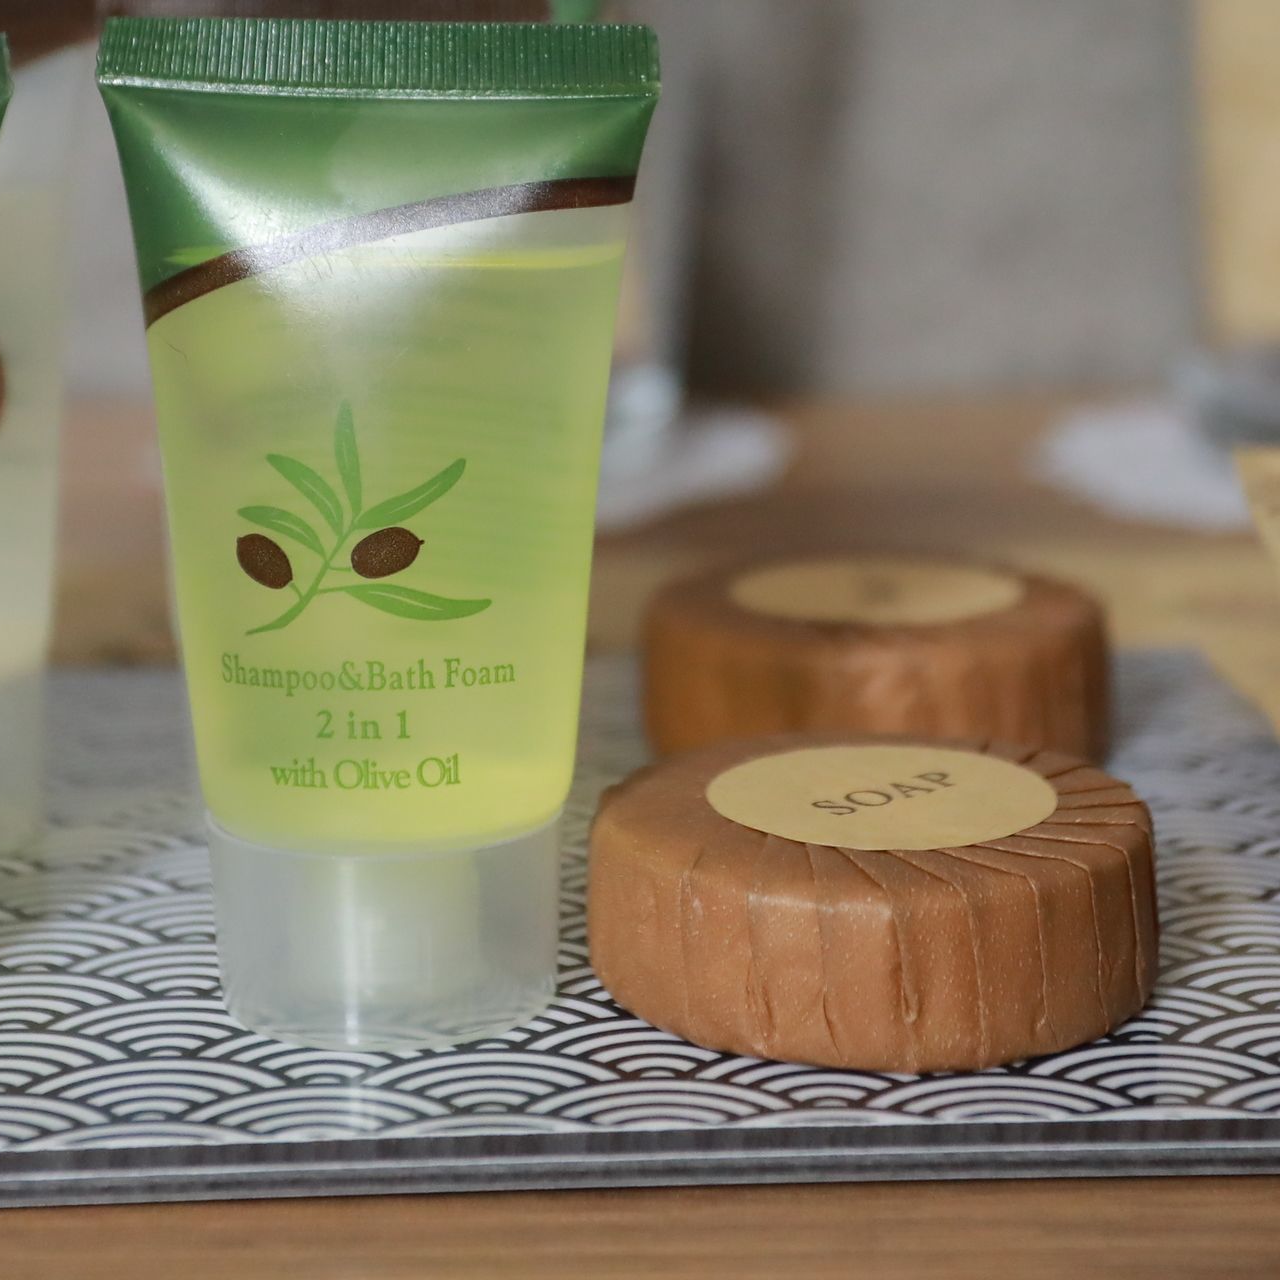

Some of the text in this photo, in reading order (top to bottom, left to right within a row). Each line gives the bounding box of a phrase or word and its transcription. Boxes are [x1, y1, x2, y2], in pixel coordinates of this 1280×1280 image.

[221, 652, 517, 697] Shampoo&Bath Foam
[315, 709, 412, 740] 2 in 1
[269, 753, 462, 790] with Olive Oil
[811, 770, 958, 817] SOAP
